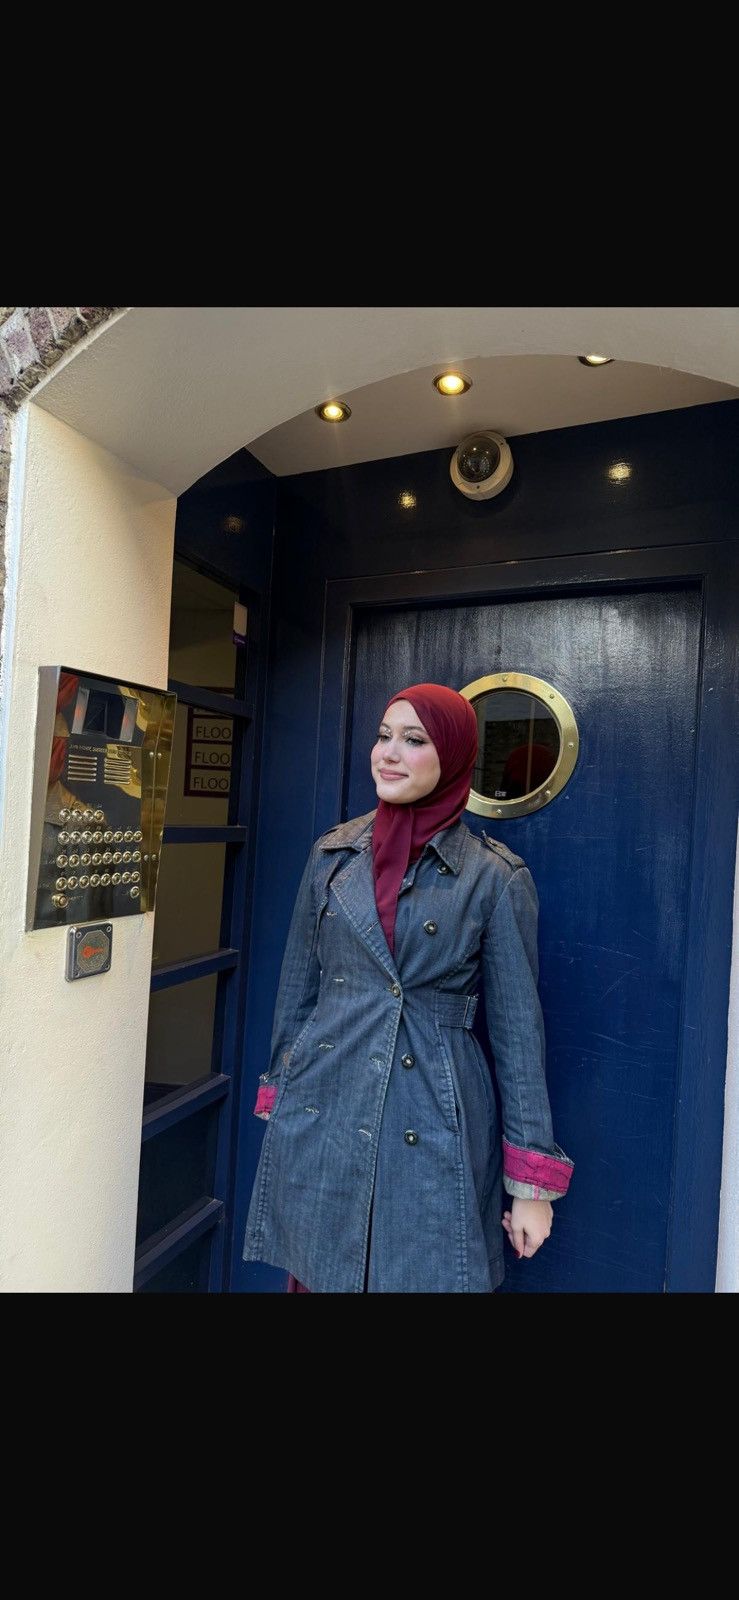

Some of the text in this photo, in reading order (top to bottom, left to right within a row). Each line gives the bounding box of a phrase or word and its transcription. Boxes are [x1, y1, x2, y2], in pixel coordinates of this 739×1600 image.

[195, 726, 231, 739] FLOO
[194, 751, 230, 764] FLOO
[193, 776, 229, 790] FLOO
